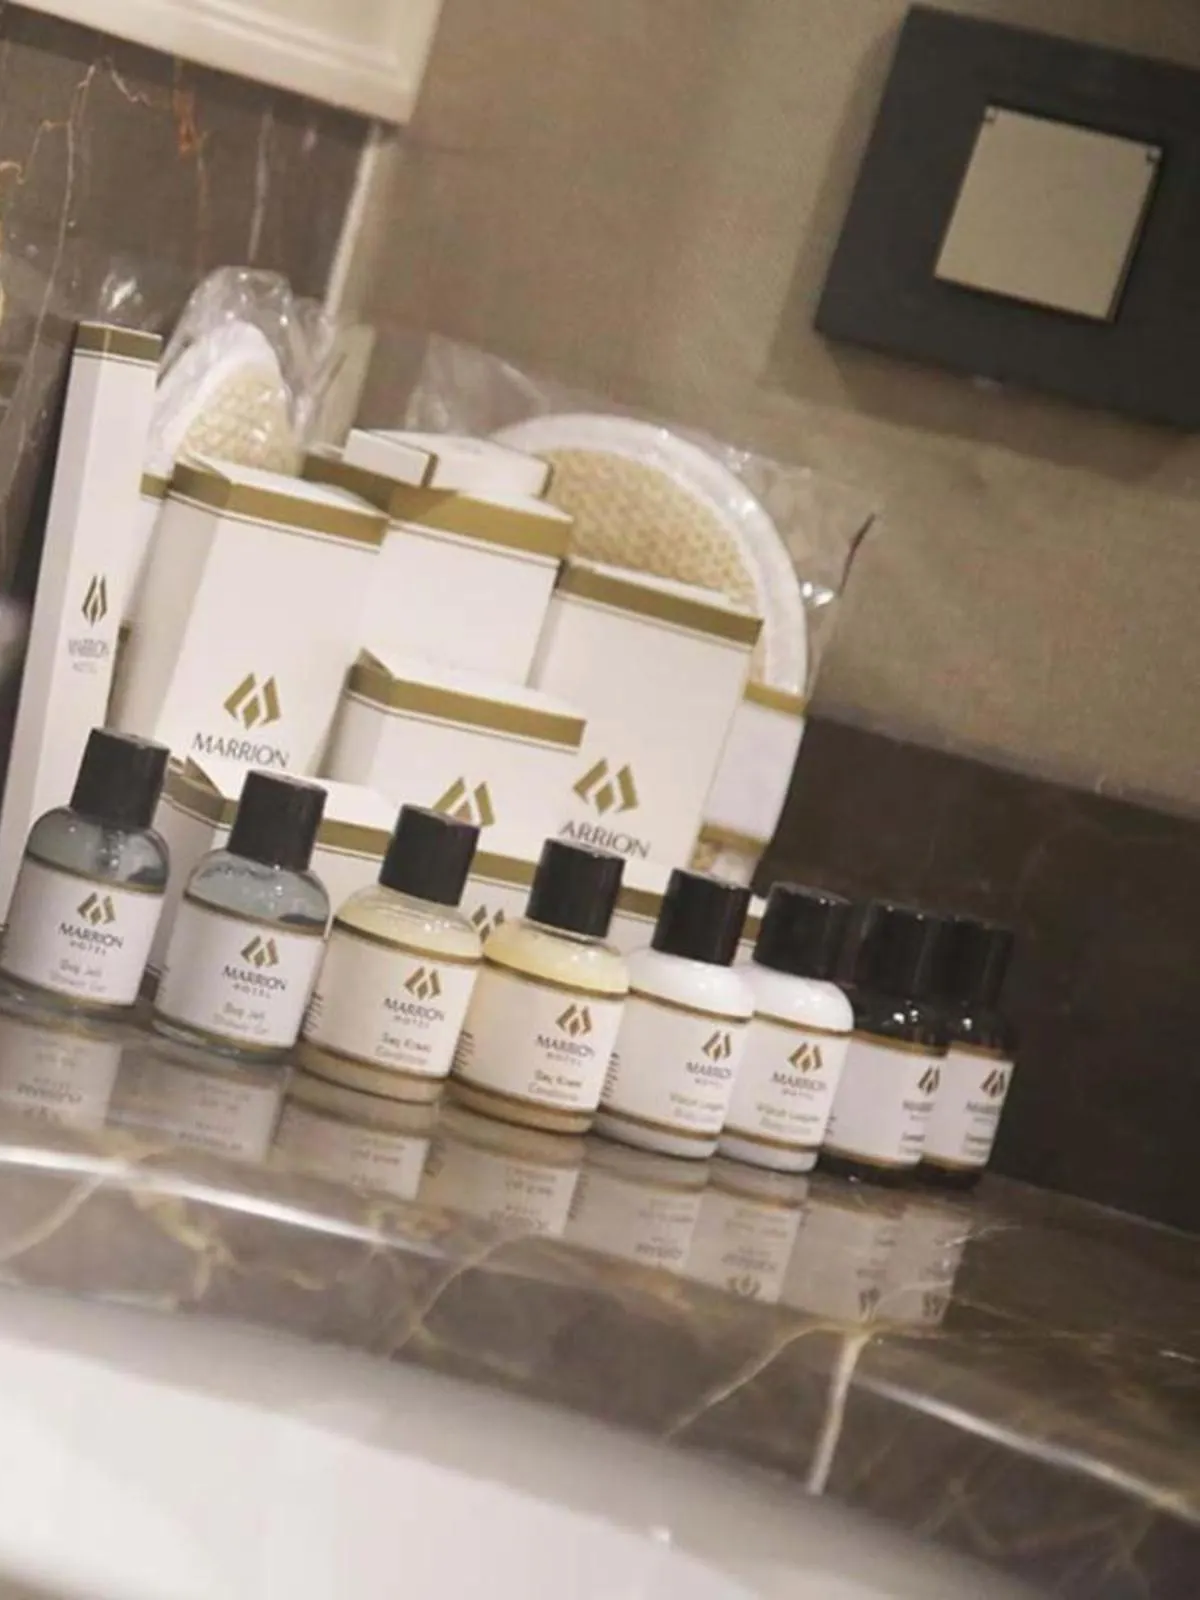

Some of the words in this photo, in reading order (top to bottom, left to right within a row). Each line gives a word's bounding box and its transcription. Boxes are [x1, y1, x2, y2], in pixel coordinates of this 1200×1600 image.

[192, 731, 290, 769] MARRION
[557, 819, 651, 859] ARRION
[58, 922, 124, 949] MARRION
[221, 965, 287, 991] MARRION
[383, 997, 446, 1022] MARRION
[535, 1034, 596, 1060] MARRION
